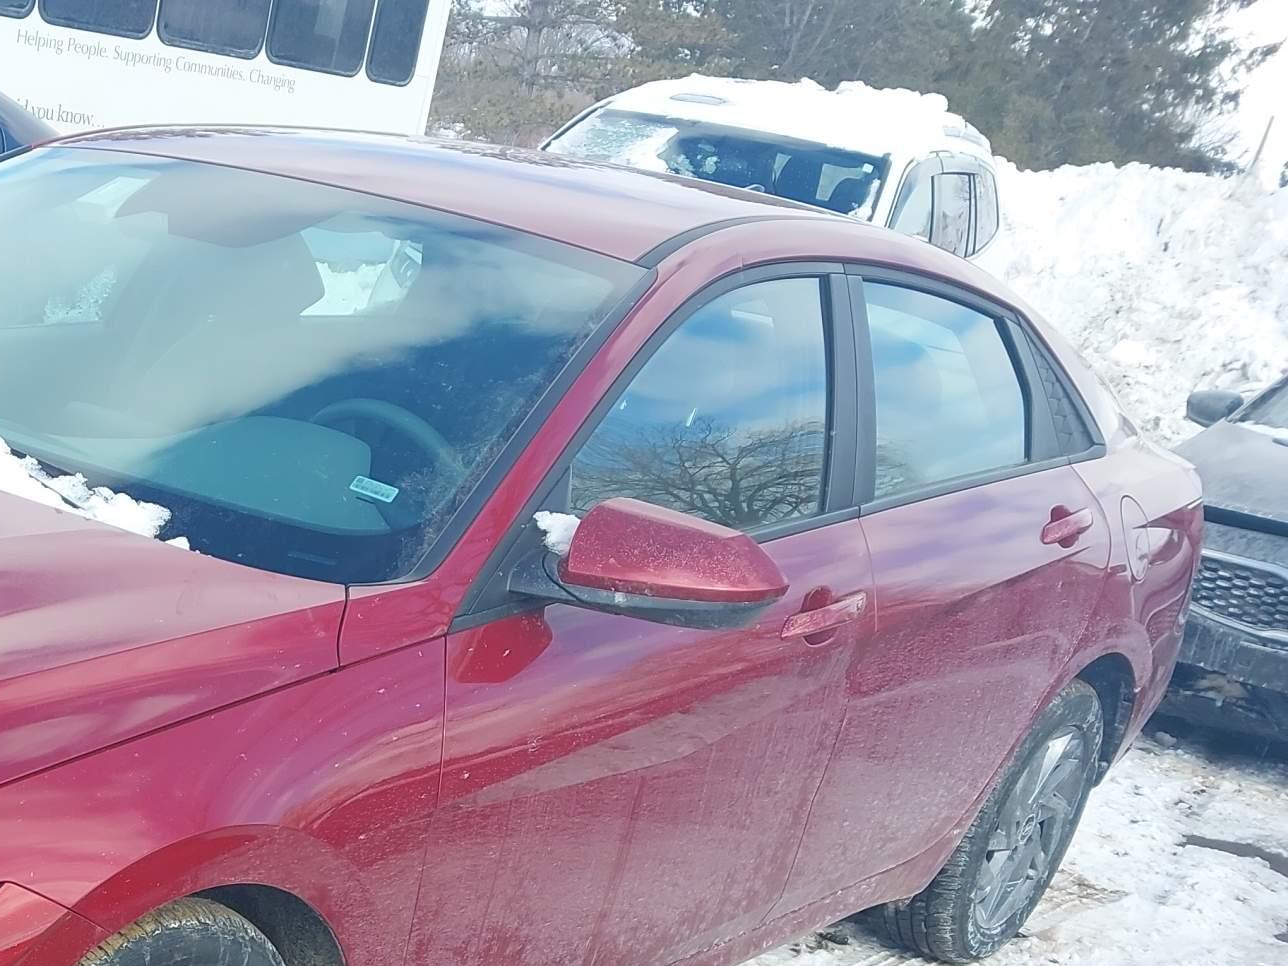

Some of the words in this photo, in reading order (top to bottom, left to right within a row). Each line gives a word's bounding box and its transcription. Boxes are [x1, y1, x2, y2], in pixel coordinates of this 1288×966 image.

[16, 28, 64, 56] Helping
[67, 37, 109, 60] People.
[112, 45, 173, 73] Supporting
[175, 55, 246, 82] Communities.
[249, 69, 296, 94] Changing
